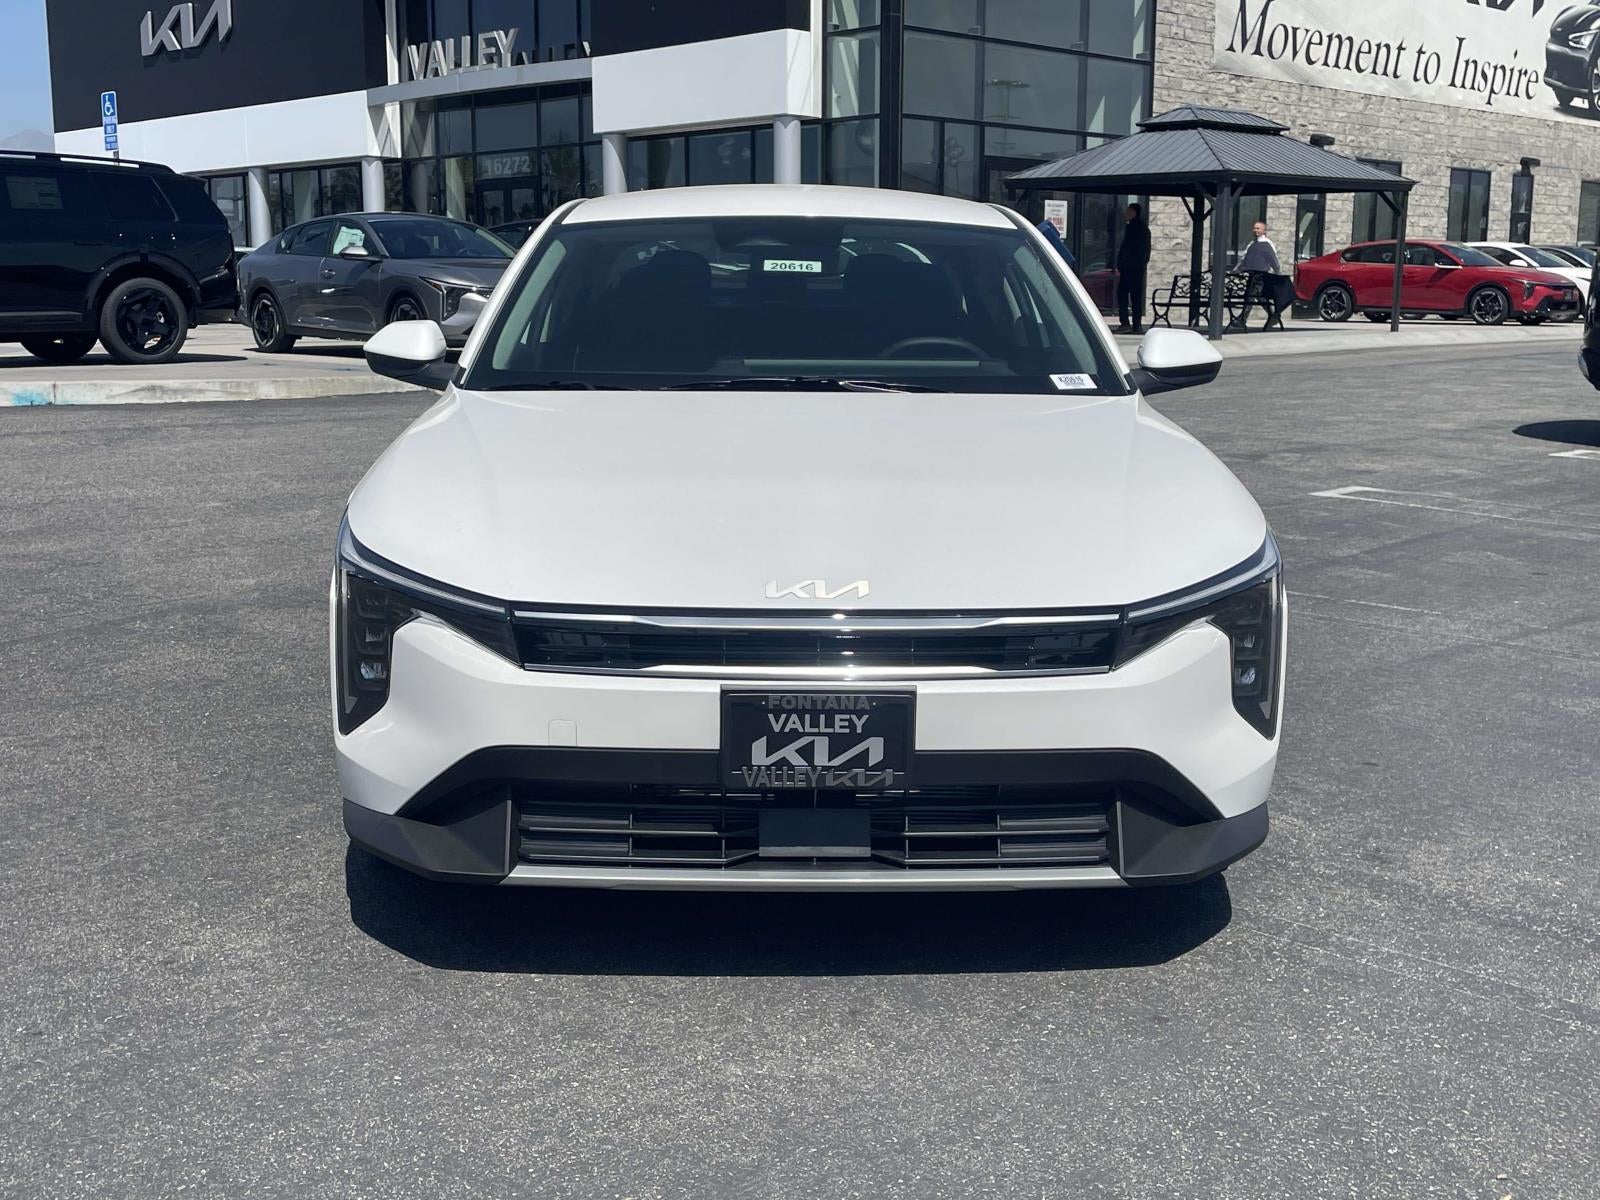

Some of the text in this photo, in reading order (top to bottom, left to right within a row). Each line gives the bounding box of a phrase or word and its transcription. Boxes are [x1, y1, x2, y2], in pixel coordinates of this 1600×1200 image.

[140, 0, 232, 56] KIA
[408, 28, 518, 80] VALLEY
[1225, 0, 1539, 106] Movement to Inspire
[485, 156, 531, 177] 16272
[770, 262, 814, 271] 20616
[765, 579, 870, 599] KIA
[768, 695, 870, 710] FONTANA
[768, 713, 869, 733] VALLEY
[751, 735, 884, 767] KIA
[742, 766, 894, 788] VALLEY KIA
